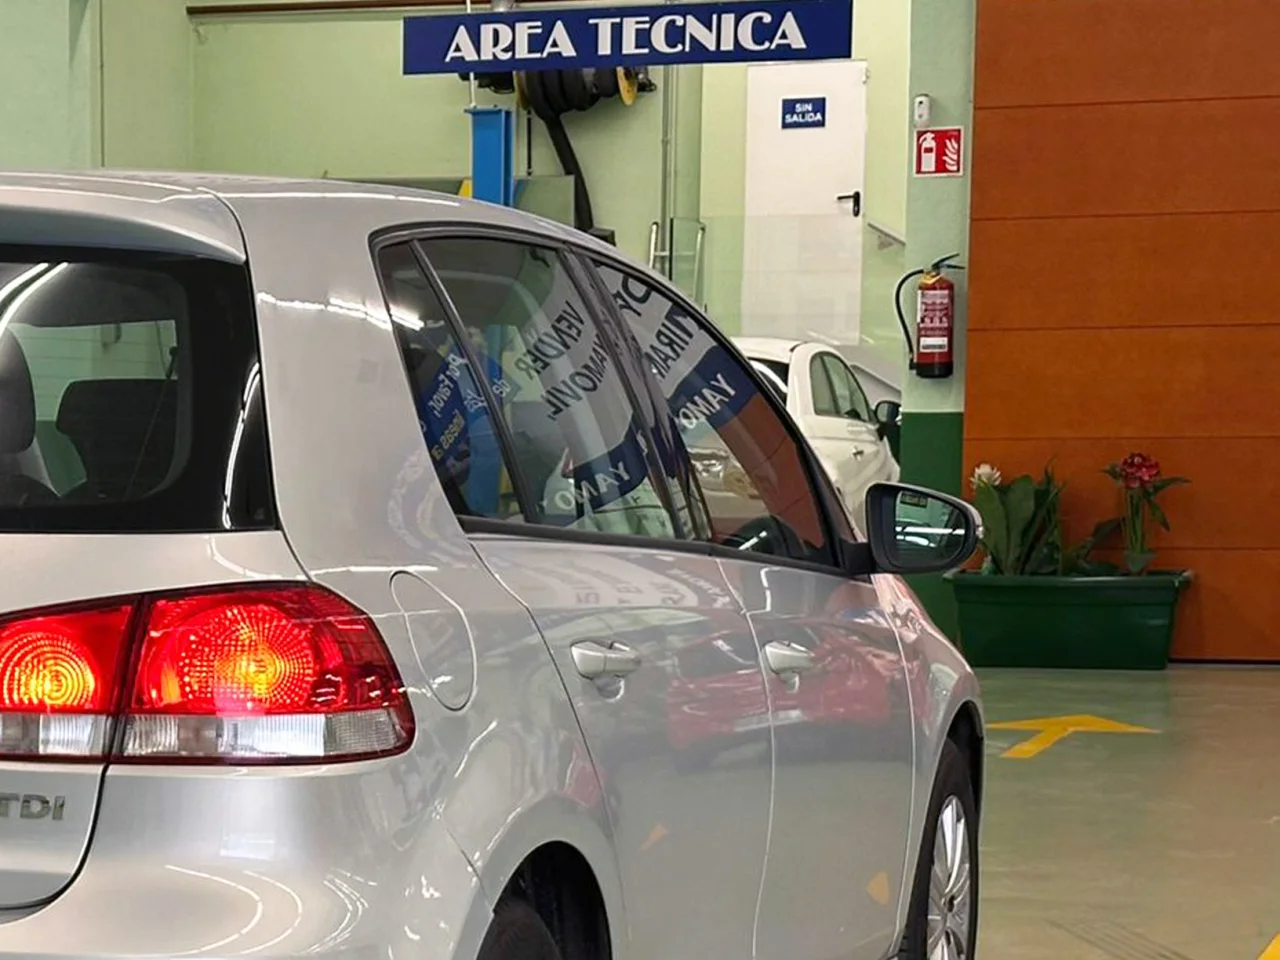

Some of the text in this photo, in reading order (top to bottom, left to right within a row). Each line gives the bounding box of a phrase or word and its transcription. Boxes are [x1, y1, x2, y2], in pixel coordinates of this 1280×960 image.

[444, 11, 807, 63] AREA TECNICA
[795, 103, 813, 113] SIN
[785, 112, 823, 124] SALIDA
